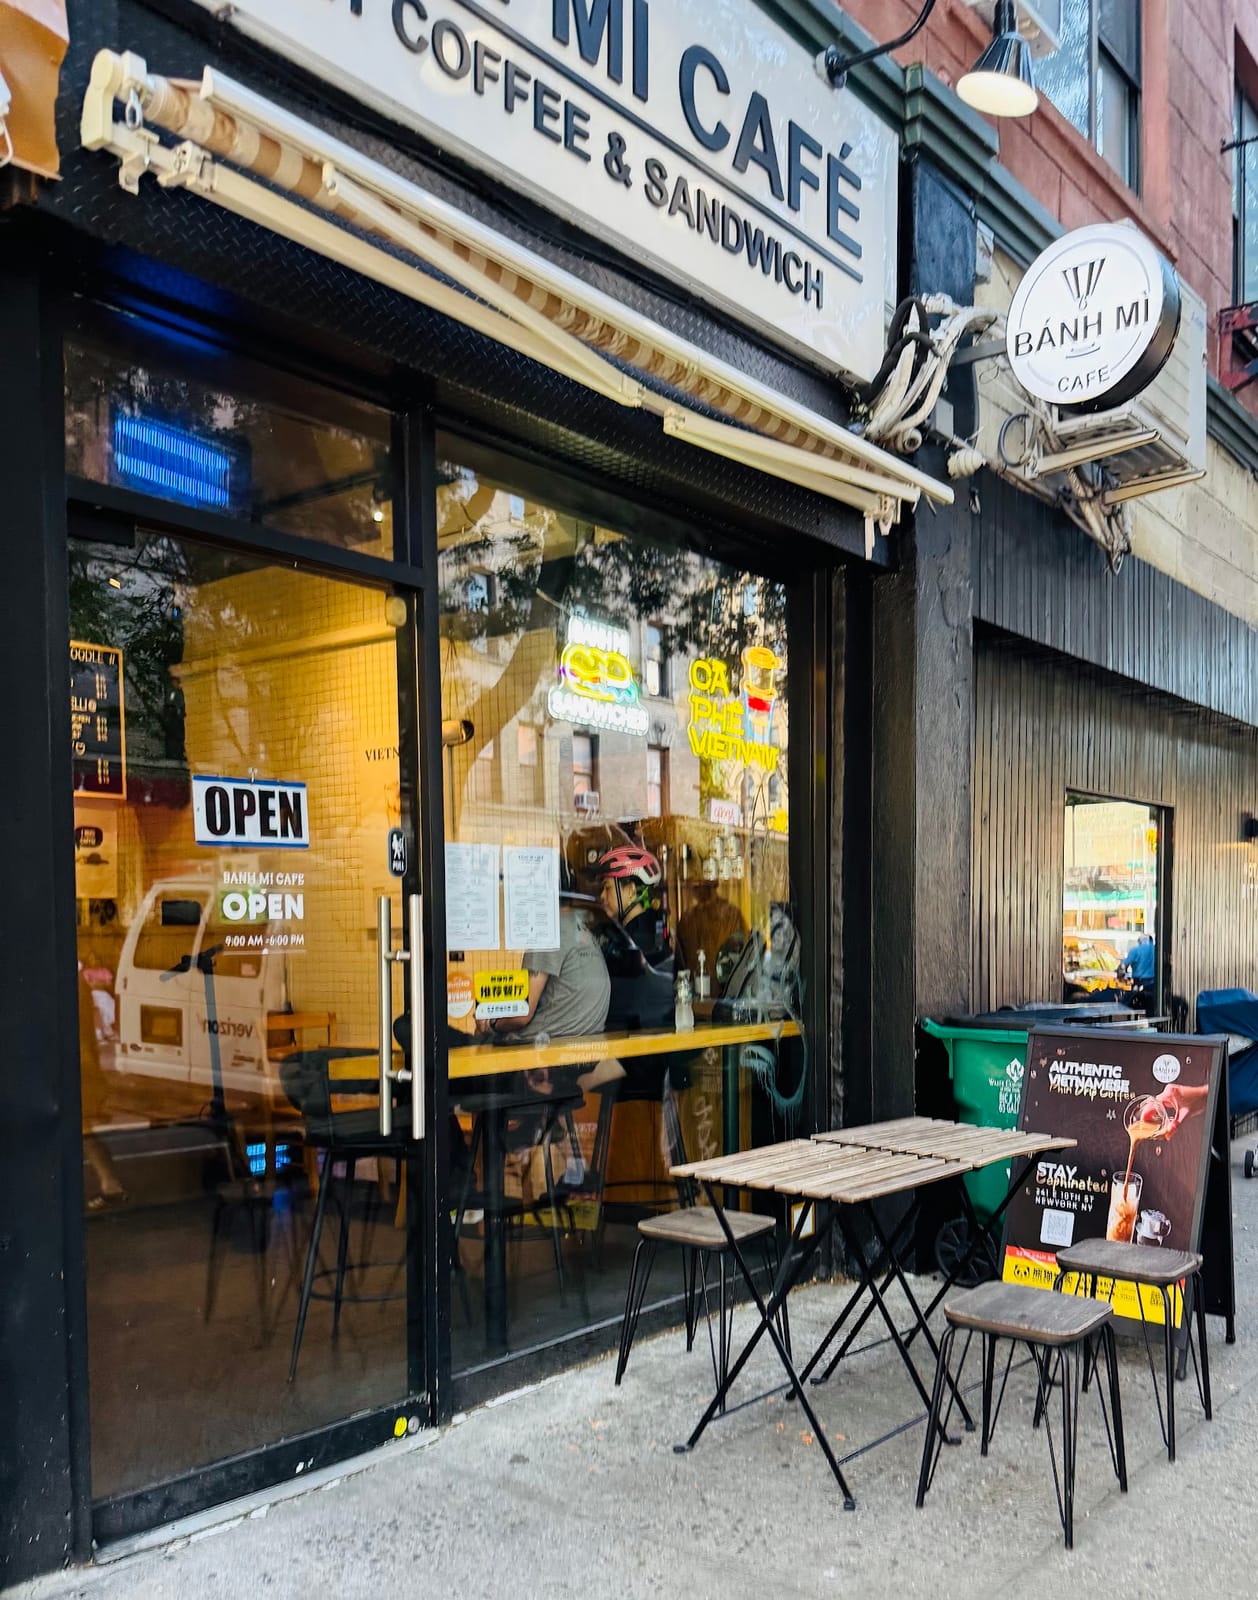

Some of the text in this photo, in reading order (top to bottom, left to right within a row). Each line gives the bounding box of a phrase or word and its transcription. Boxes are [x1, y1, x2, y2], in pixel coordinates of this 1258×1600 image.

[391, 0, 824, 310] COFFEE & SANDWICH
[678, 44, 863, 259] CAFÉ
[1014, 311, 1103, 358] BÁNH
[1057, 364, 1111, 393] CAFE
[688, 726, 780, 772] VIETNAM
[205, 785, 303, 839] OPEN
[222, 892, 304, 921] OPEN
[247, 935, 264, 947] AM
[290, 934, 305, 946] PM
[1048, 1072, 1131, 1093] VIETNAMESE
[1049, 1060, 1123, 1079] AUTHENTIC
[1037, 1161, 1078, 1180] STAY
[1080, 1202, 1093, 1213] NY
